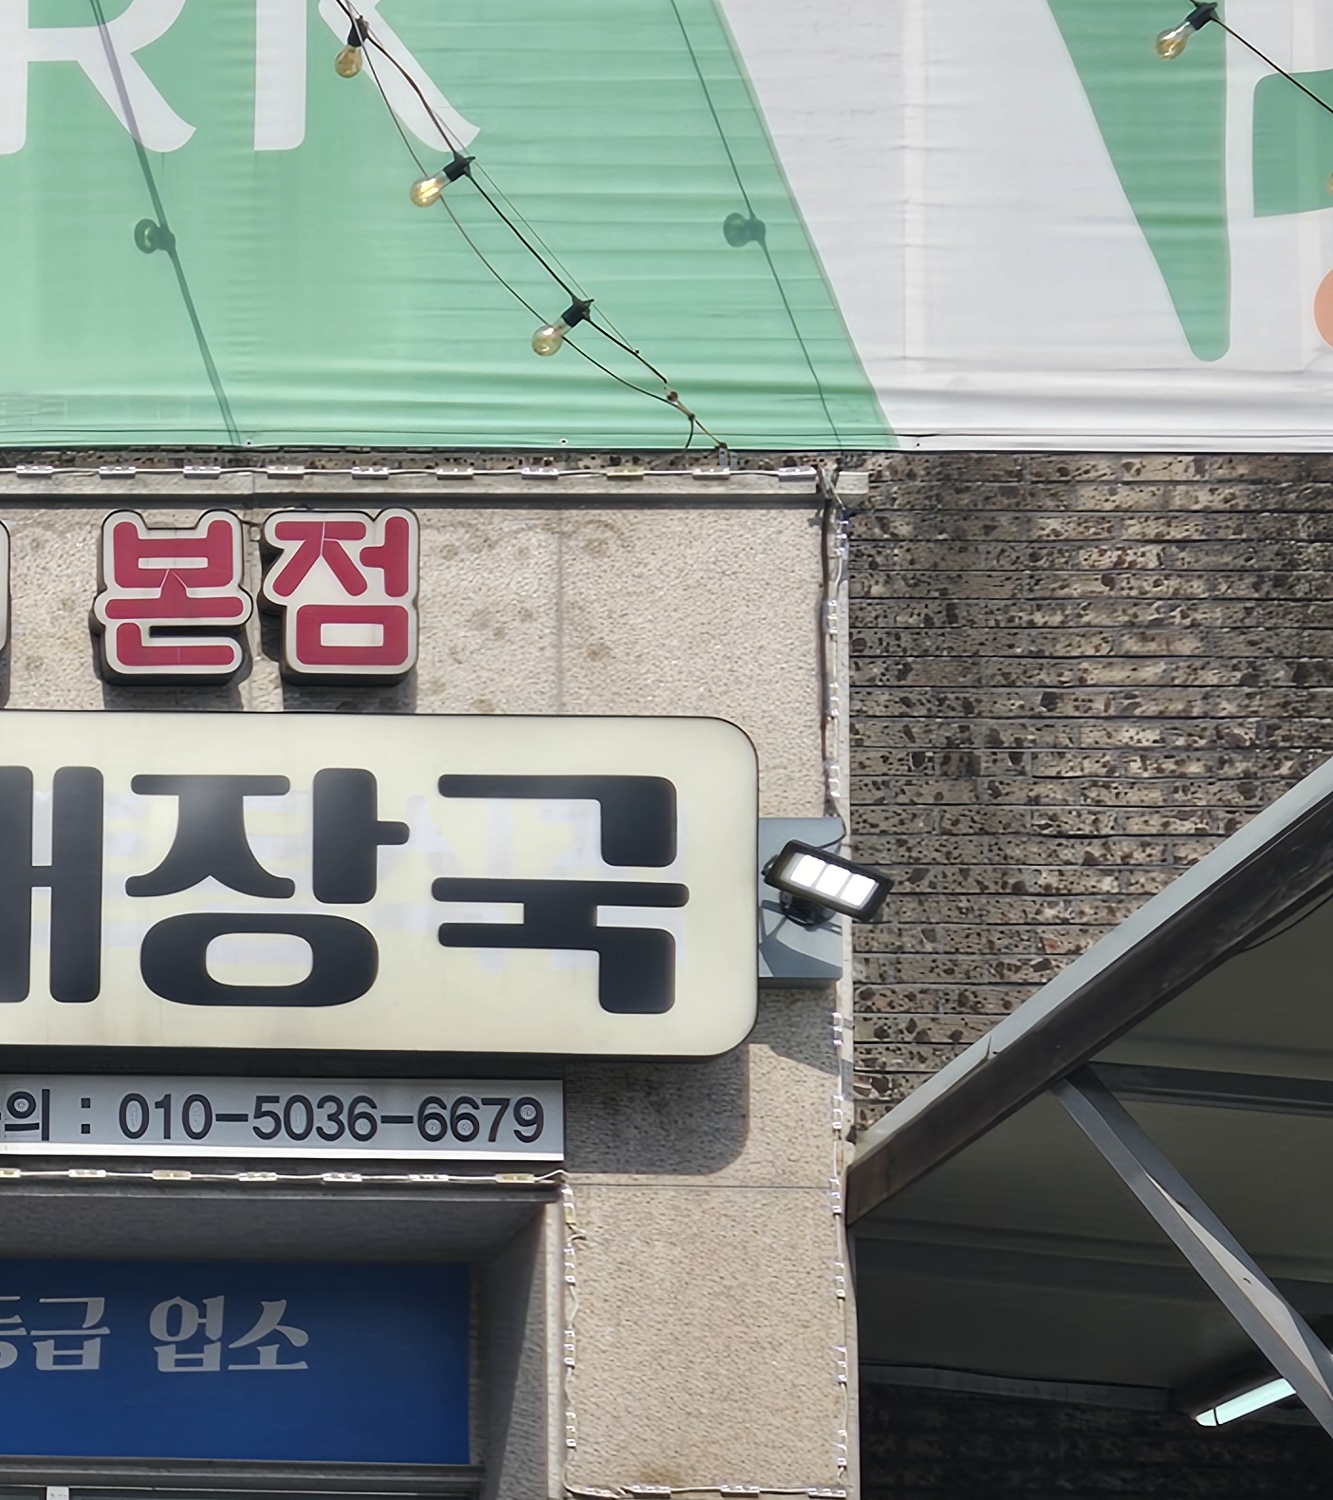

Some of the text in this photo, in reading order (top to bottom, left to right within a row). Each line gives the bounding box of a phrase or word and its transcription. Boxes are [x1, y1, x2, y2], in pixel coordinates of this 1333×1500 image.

[104, 516, 410, 670] 본점
[116, 1090, 545, 1145] 010-5036-6679
[148, 1294, 310, 1374] 업소
